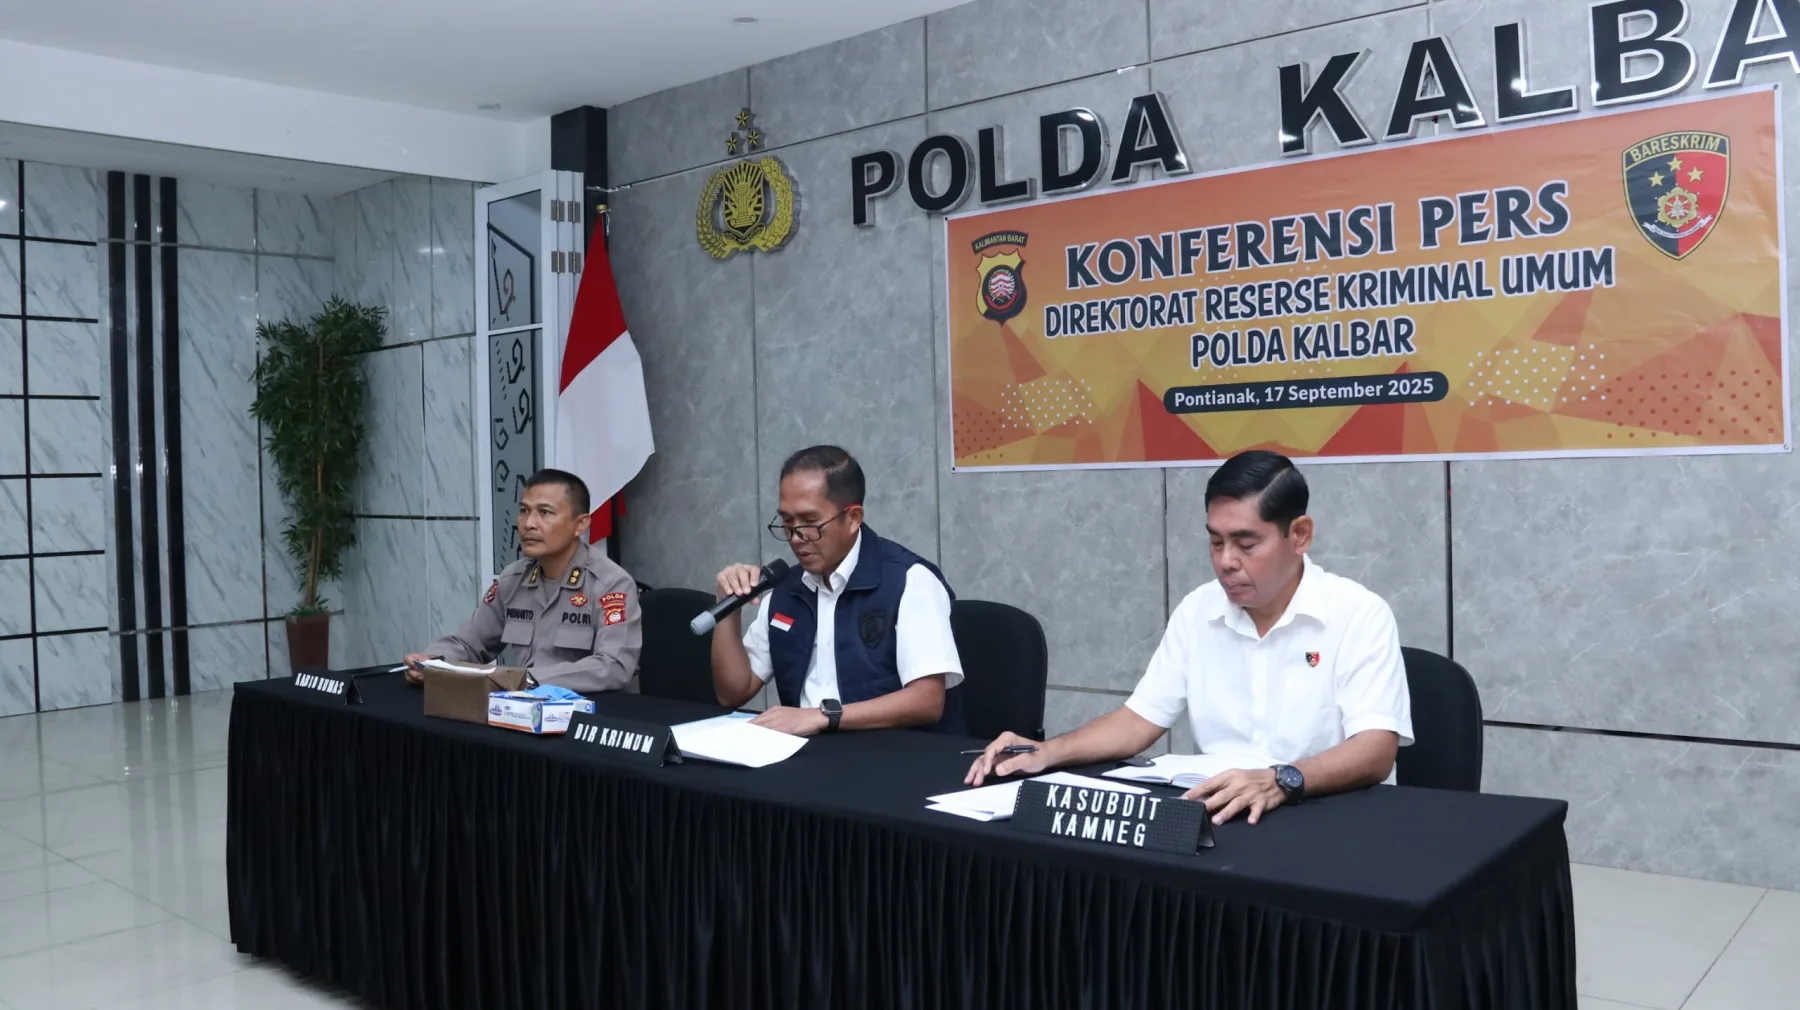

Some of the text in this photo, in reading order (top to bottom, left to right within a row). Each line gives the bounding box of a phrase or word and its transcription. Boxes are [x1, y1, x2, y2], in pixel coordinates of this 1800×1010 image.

[851, 0, 1800, 228] POLDA KALBA
[1630, 134, 1721, 162] BARESKRIM
[974, 233, 1026, 250] KALIMANTAN BARAT
[1064, 179, 1570, 290] KONFERENSI PERS
[1045, 246, 1616, 338] DIREKTORAT RESERSE KRIMINAL UMUM
[1190, 316, 1418, 369] POLDA KALBAR
[1174, 377, 1434, 407] Pontianak, 17 September 2025
[602, 593, 625, 603] POLDA
[562, 612, 592, 624] POLRI
[574, 723, 655, 754] DIR KRIMUM
[1046, 784, 1161, 820] KASUBDIT
[1051, 812, 1146, 847] KAMNEG
